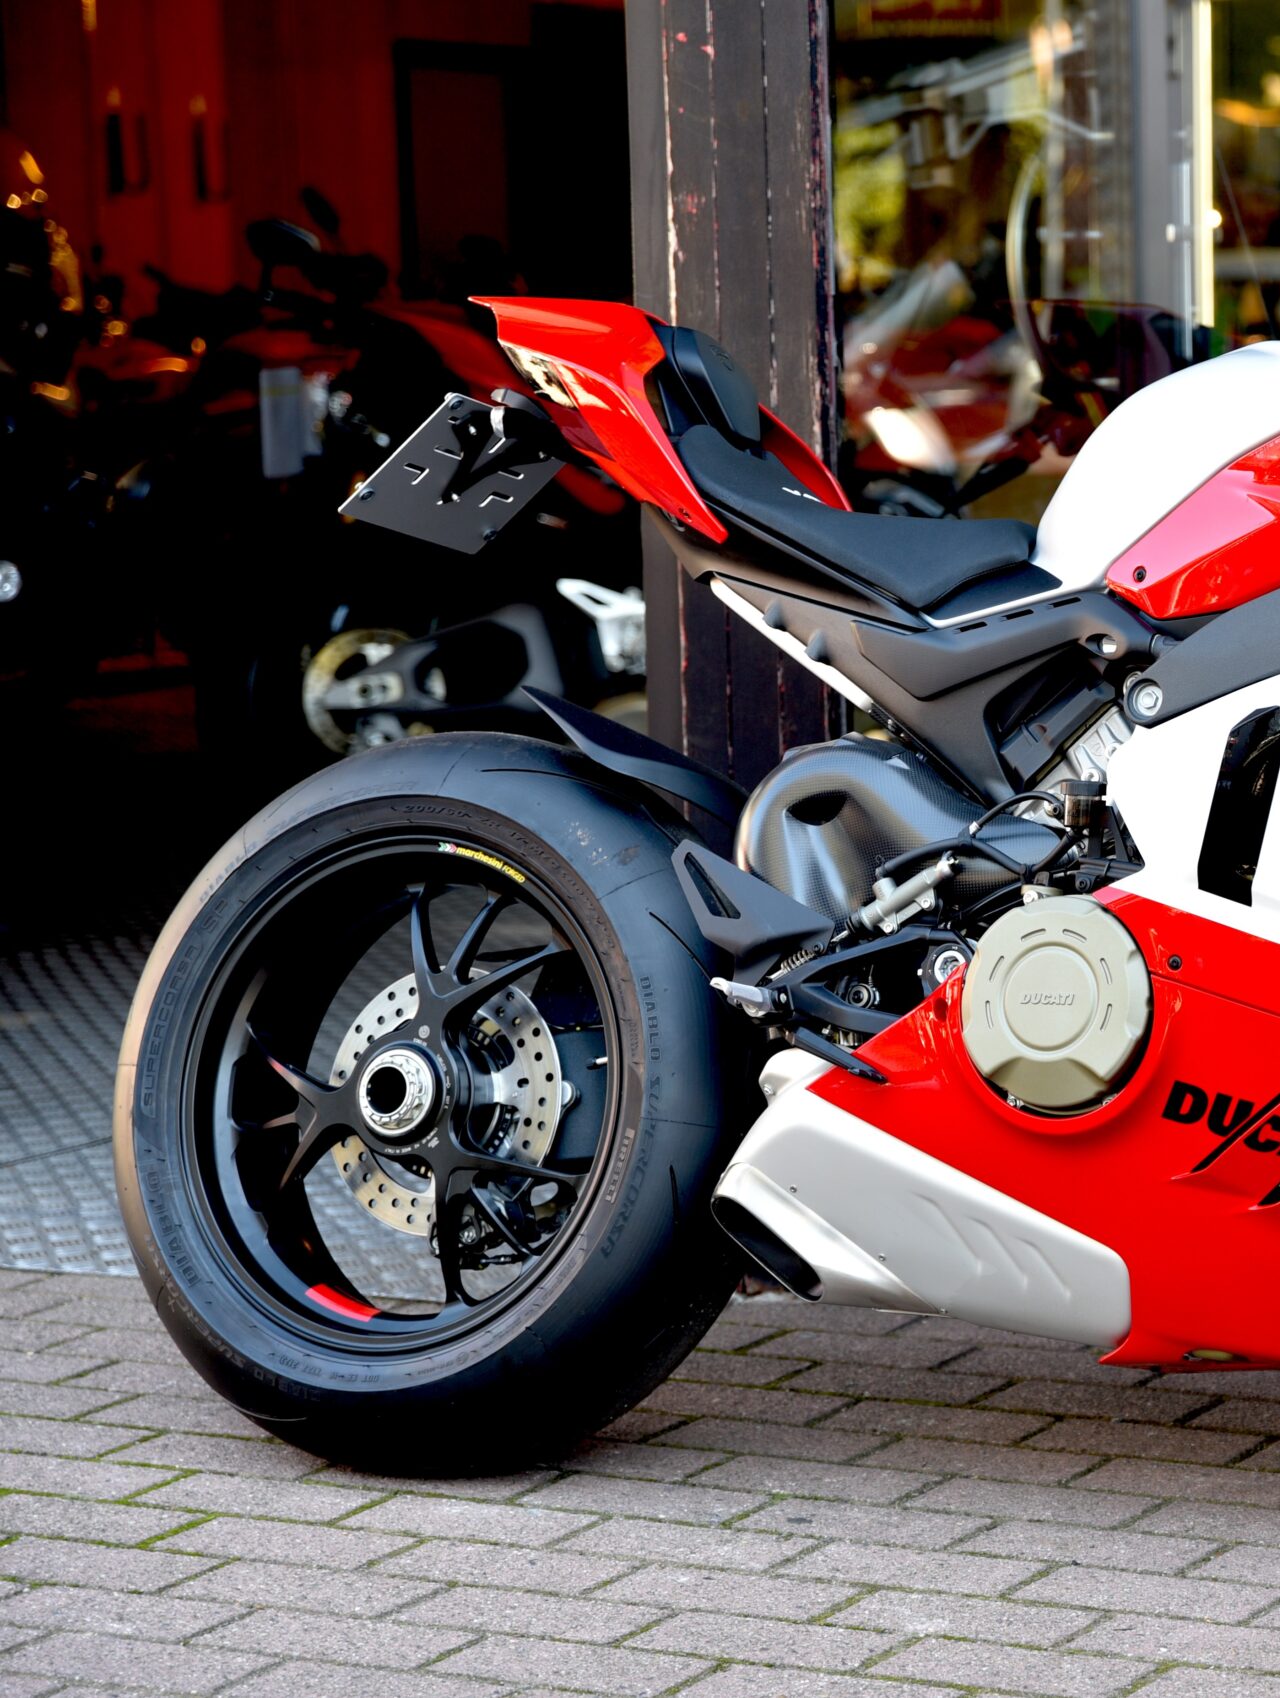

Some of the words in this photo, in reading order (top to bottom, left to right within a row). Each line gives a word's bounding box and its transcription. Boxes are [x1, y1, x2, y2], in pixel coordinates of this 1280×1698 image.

[456, 847, 504, 871] marchesini
[502, 864, 527, 884] FORGED
[142, 944, 200, 1107] SUPERCORSA
[639, 974, 662, 1062] DIABLO
[1019, 992, 1075, 1007] DUCATI
[146, 1171, 200, 1289] DIABLO
